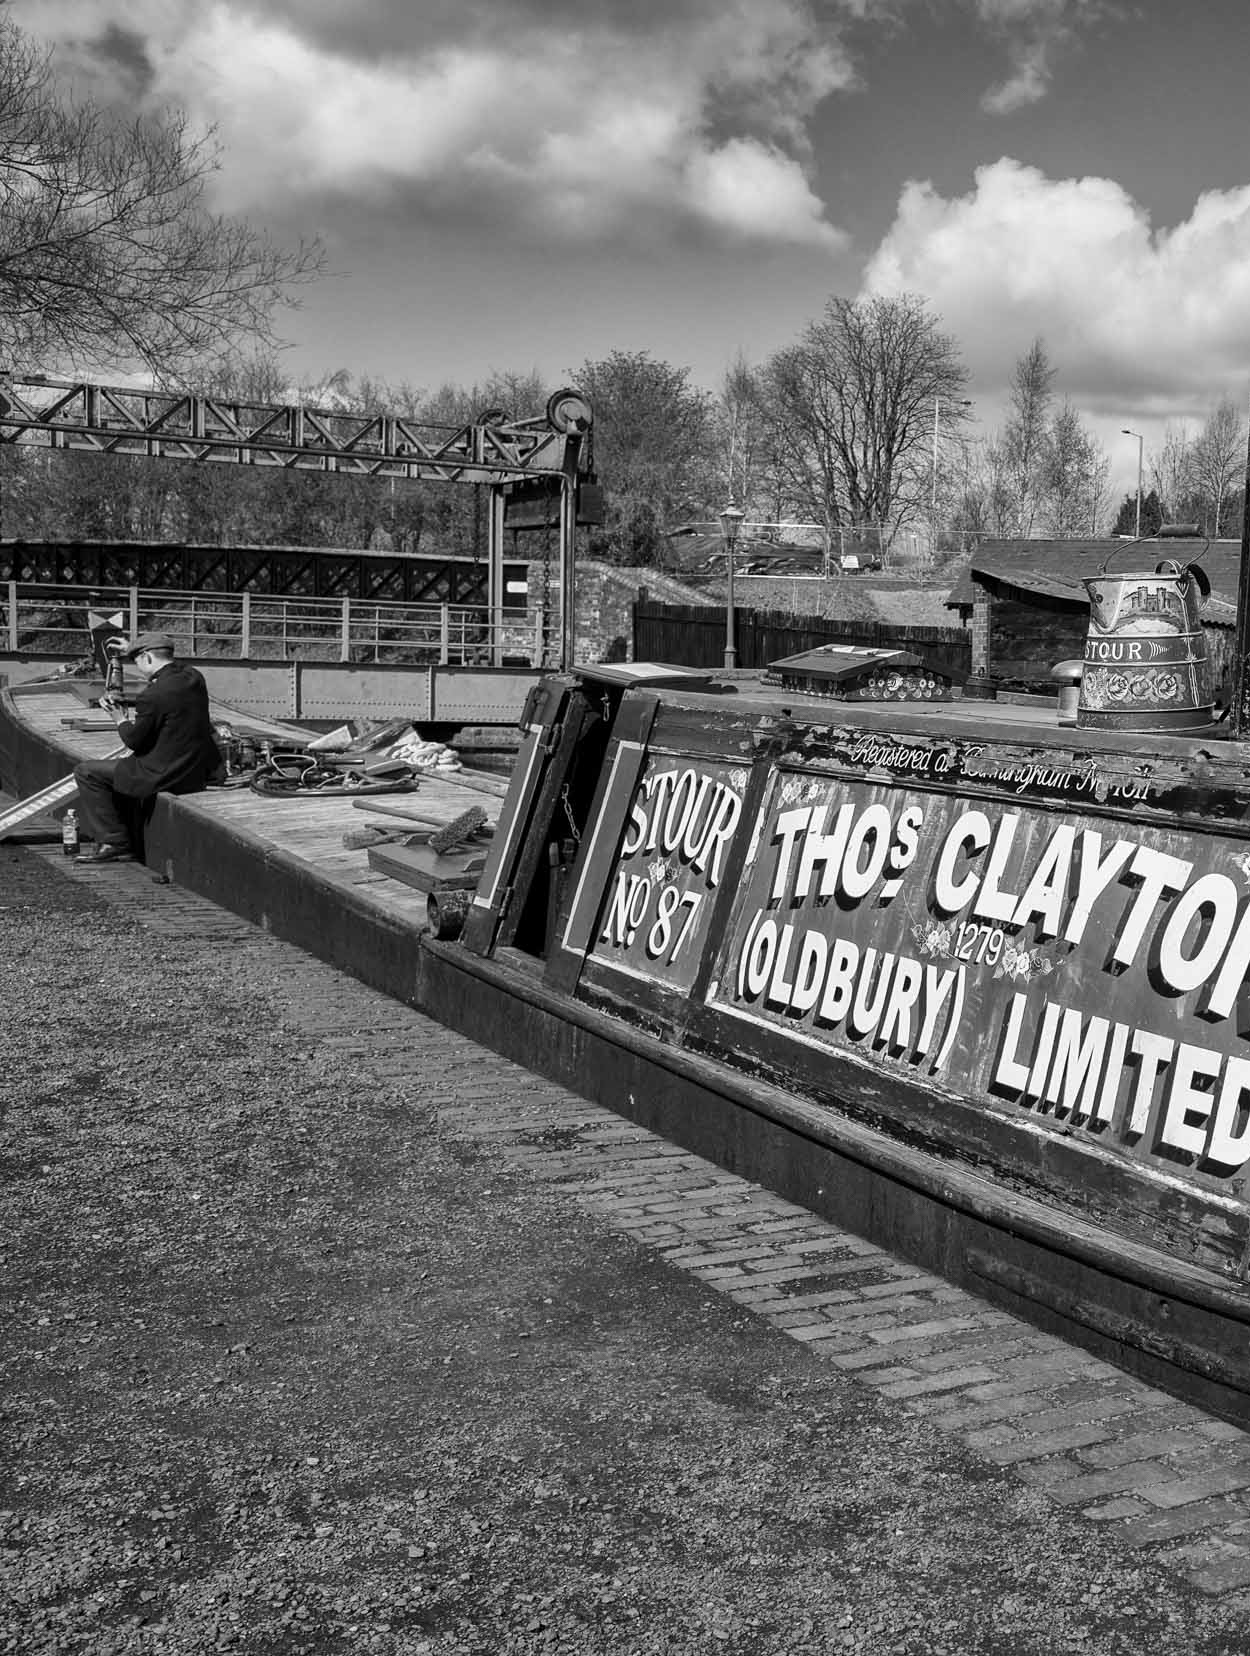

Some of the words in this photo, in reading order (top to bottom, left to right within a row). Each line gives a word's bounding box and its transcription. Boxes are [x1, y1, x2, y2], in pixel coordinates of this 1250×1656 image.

[1084, 640, 1142, 660] STOUR
[851, 734, 933, 771] Registered
[934, 752, 952, 773] a
[621, 769, 742, 886] STOUR
[649, 886, 702, 962] 87
[954, 921, 1004, 966] 1279
[738, 908, 966, 1069] (OLDBURY)
